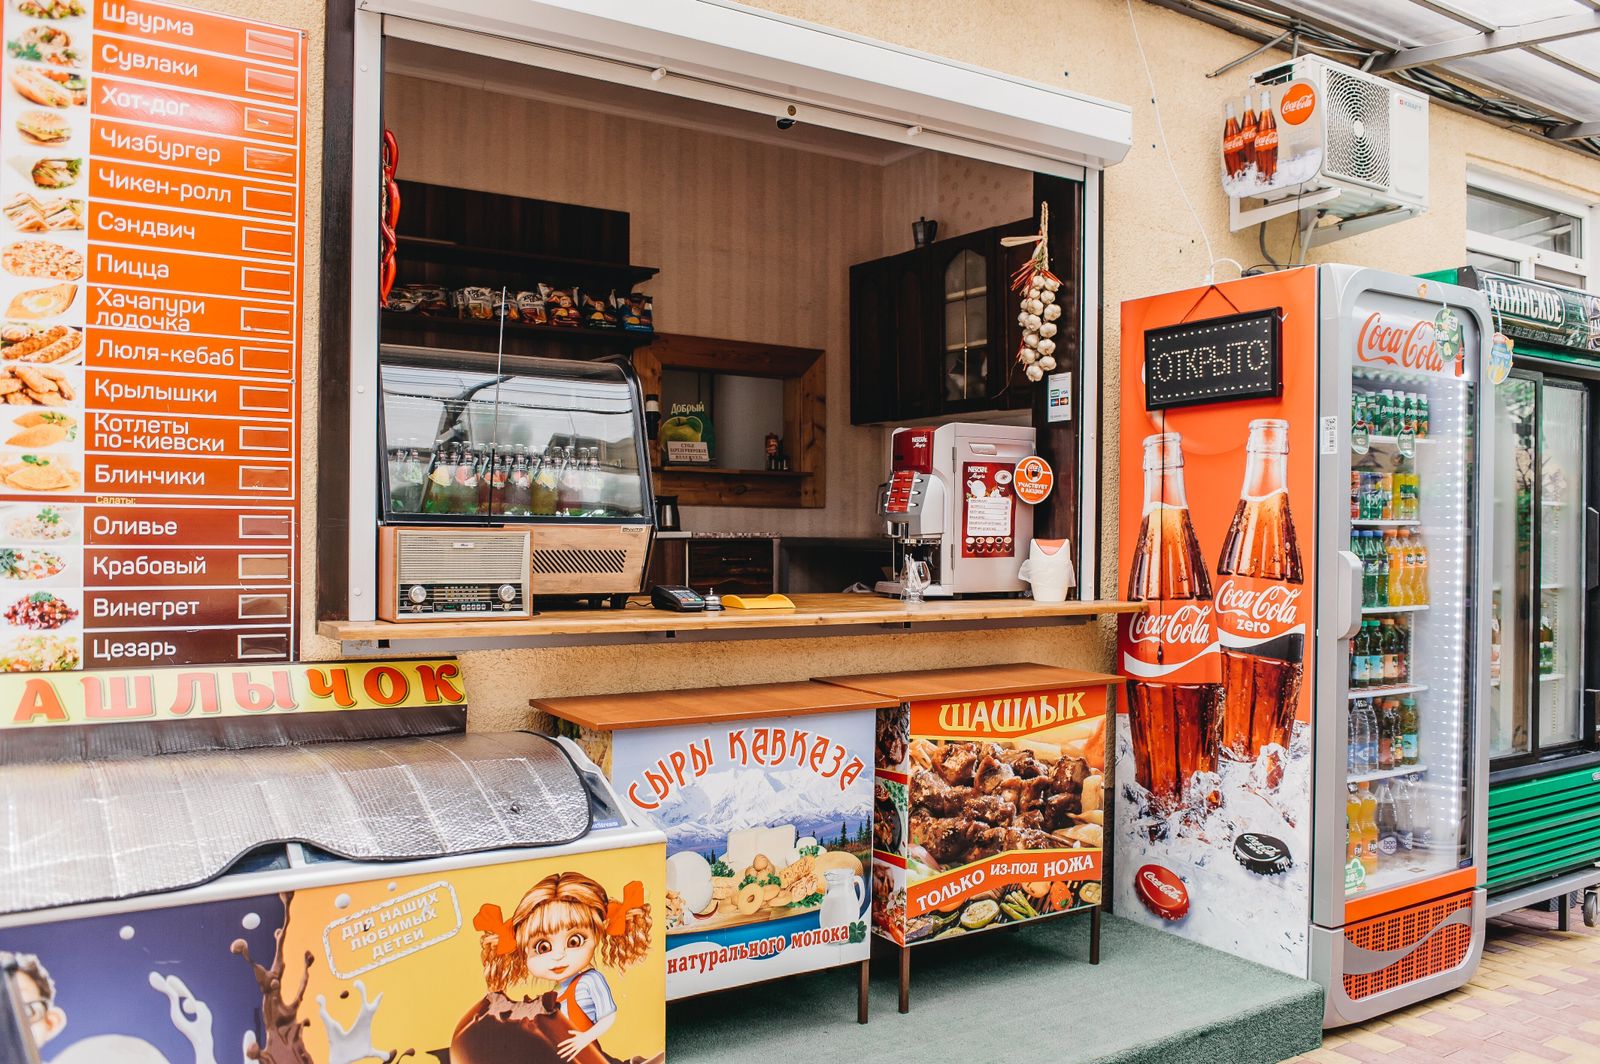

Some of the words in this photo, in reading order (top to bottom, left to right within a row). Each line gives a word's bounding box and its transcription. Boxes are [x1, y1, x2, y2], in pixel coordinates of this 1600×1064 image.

[102, 2, 194, 36] Шаурма
[102, 44, 198, 77] Сувлаки
[102, 85, 190, 116] Хот-дог
[1282, 94, 1313, 115] Coca-Cola
[101, 127, 221, 165] Чизбургер
[99, 168, 232, 203] Чикен-ролл
[97, 211, 195, 240] Сэндвич
[96, 253, 170, 280] Пицца
[96, 288, 205, 315] Хачапури
[96, 310, 190, 333] лодочка
[96, 340, 235, 367] Люля-кебаб
[1357, 312, 1446, 372] Coca-Cola
[1157, 339, 1265, 382] ОТКРЫТО
[95, 379, 217, 403] Крылышки
[95, 413, 189, 435] Котлеты
[95, 433, 224, 452] по-киевски
[95, 464, 205, 485] Блинчики
[93, 516, 178, 536] Оливье
[93, 555, 206, 579] Крабовый
[93, 598, 199, 620] Винегрет
[1215, 579, 1303, 624] Coca-Cola
[1129, 605, 1212, 644] Coca-Cola
[1236, 618, 1270, 634] zero
[93, 639, 177, 659] Цезарь
[939, 691, 1087, 732] ШАШЛЫК
[628, 738, 715, 810] СЫРЫ
[728, 728, 865, 791] КАВКАЗА
[916, 869, 985, 912] ТОЛЬКО
[990, 862, 1038, 877] ИЗ-ПОД
[1044, 854, 1094, 878] НОЖА
[1143, 871, 1184, 903] Coca-Cola
[342, 917, 376, 940] ДЛЯ
[380, 892, 439, 922] НАШИХ
[351, 908, 438, 951] ЛЮБИМЫХ
[667, 935, 786, 975] натурального
[791, 924, 849, 949] молока
